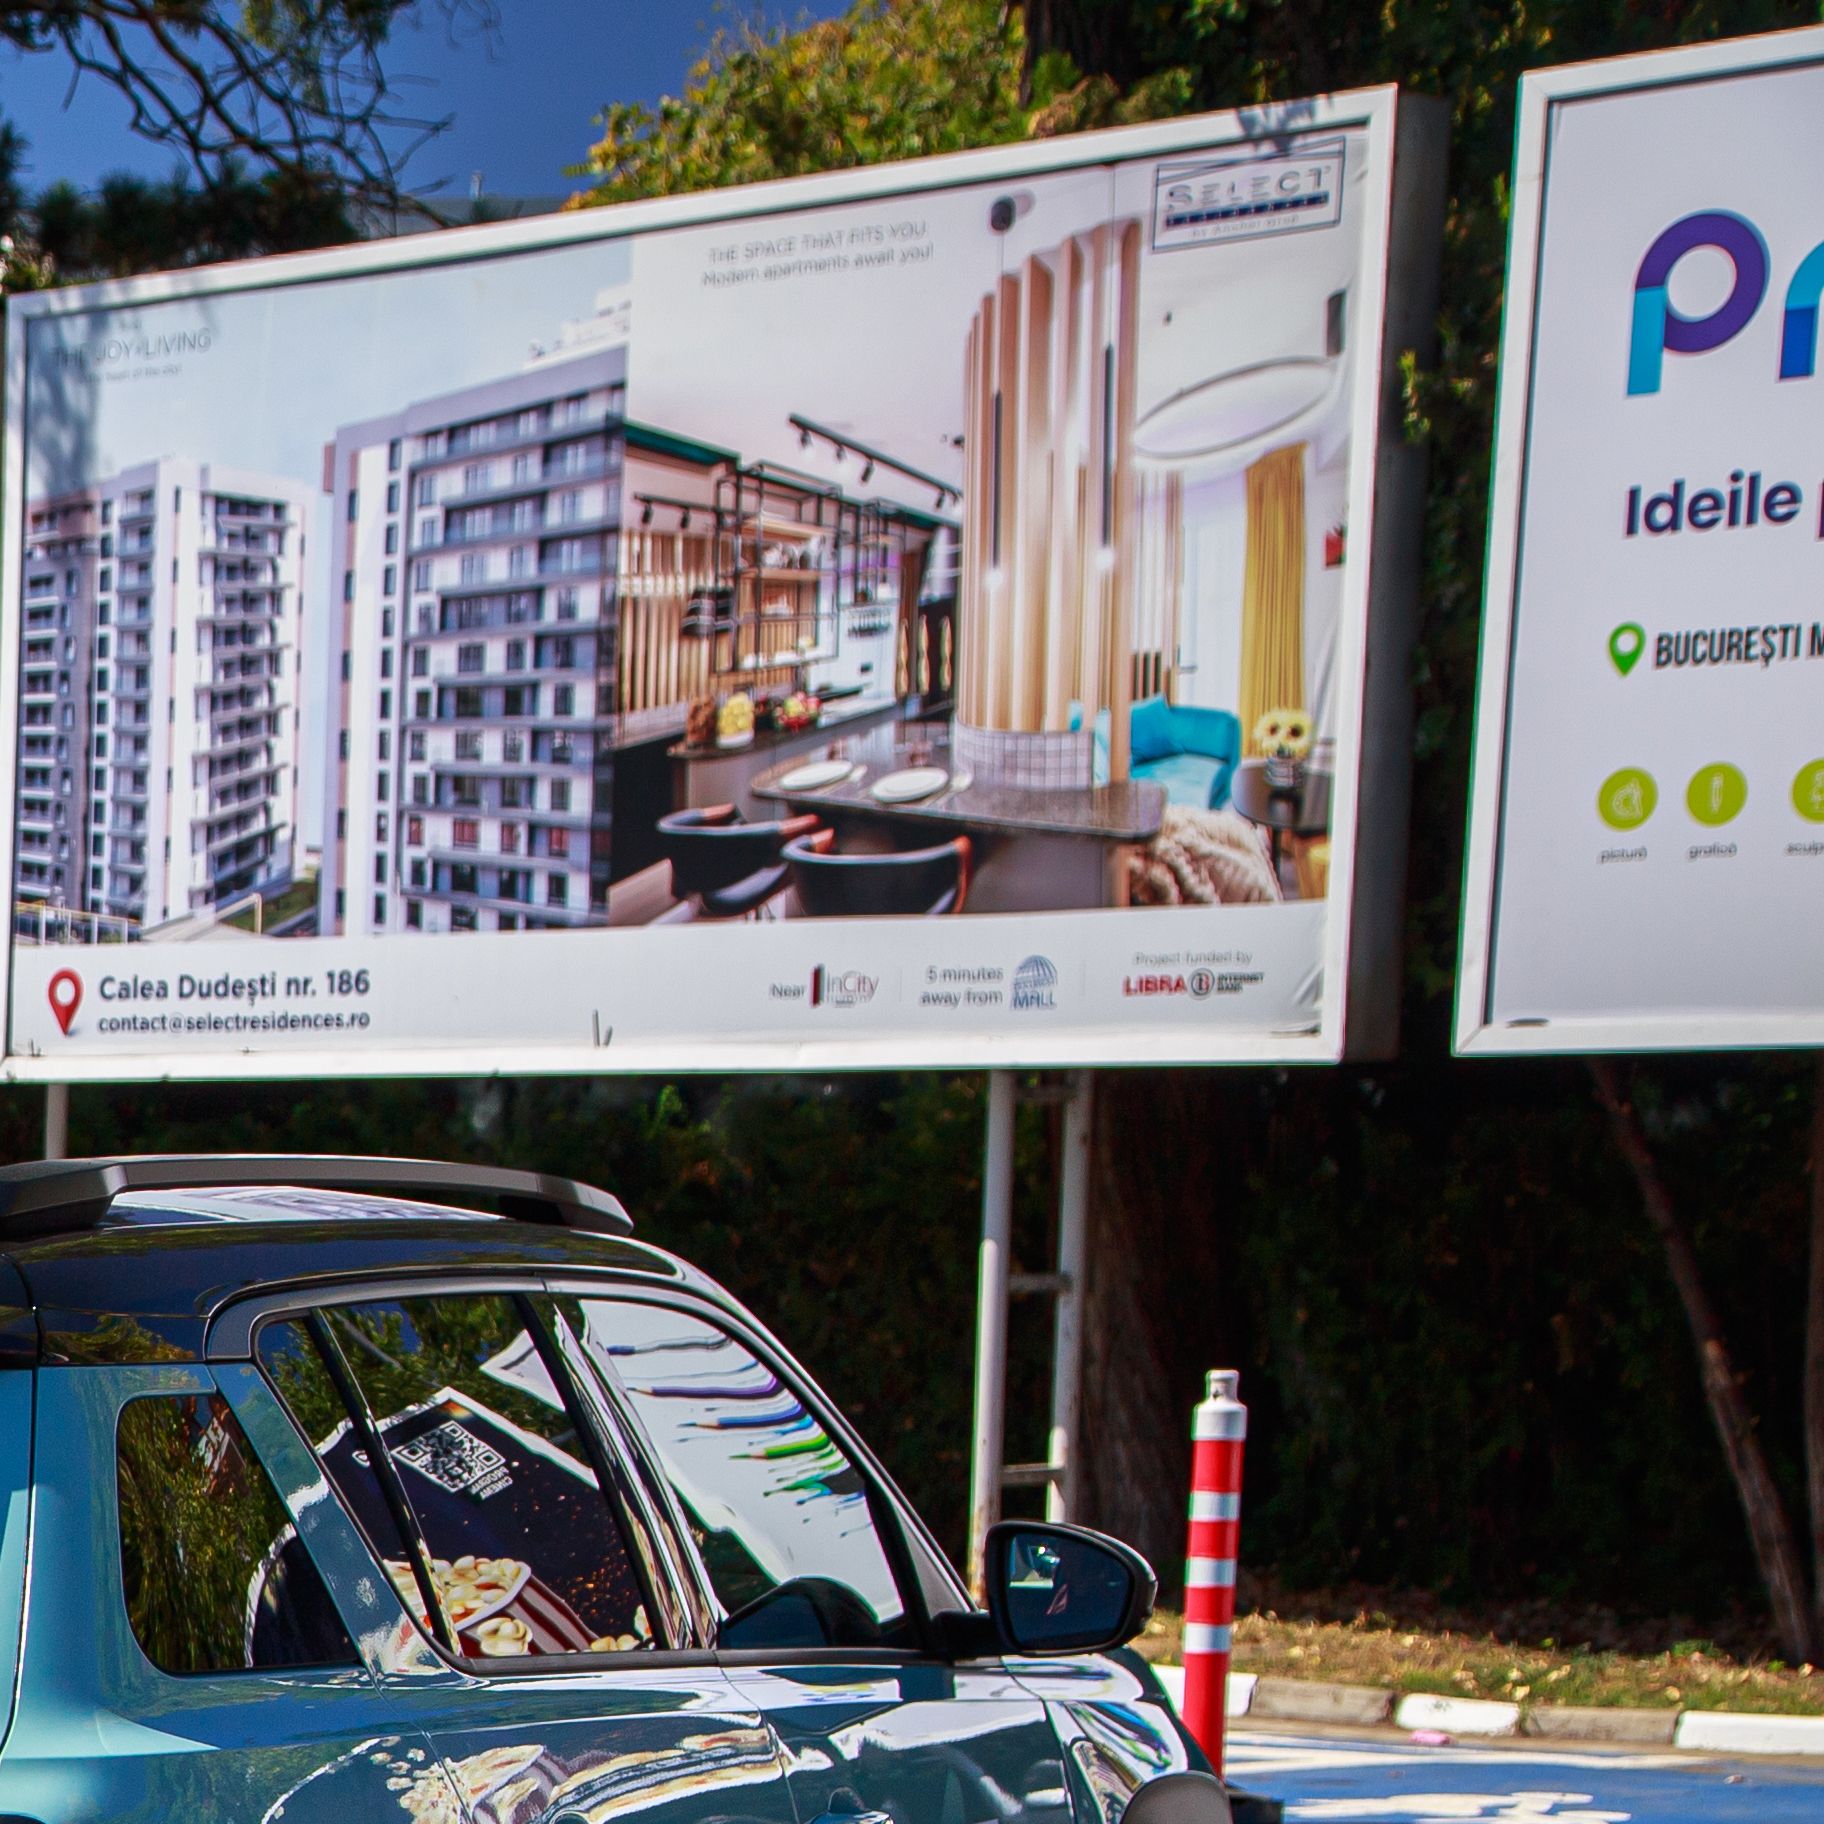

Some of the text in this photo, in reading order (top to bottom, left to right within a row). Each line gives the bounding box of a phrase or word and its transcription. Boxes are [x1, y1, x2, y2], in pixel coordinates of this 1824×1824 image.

[1166, 168, 1322, 212] SELECT
[709, 246, 738, 264] THE
[744, 236, 796, 261] SPACE
[802, 229, 844, 250] THAT
[889, 219, 927, 241] YOU
[704, 268, 759, 288] Modern
[763, 255, 849, 282] apartments
[853, 248, 894, 268] await
[144, 327, 212, 358] LIVING
[1625, 468, 1804, 540] Ideile
[99, 969, 371, 1008] Calea Dudești nr. 186
[927, 963, 1003, 983] 5 minutes
[1123, 974, 1188, 997] LIBRA
[769, 983, 805, 1000] Near
[921, 986, 1003, 1009] away from
[97, 1009, 371, 1035] contact@selectresidences.ro
